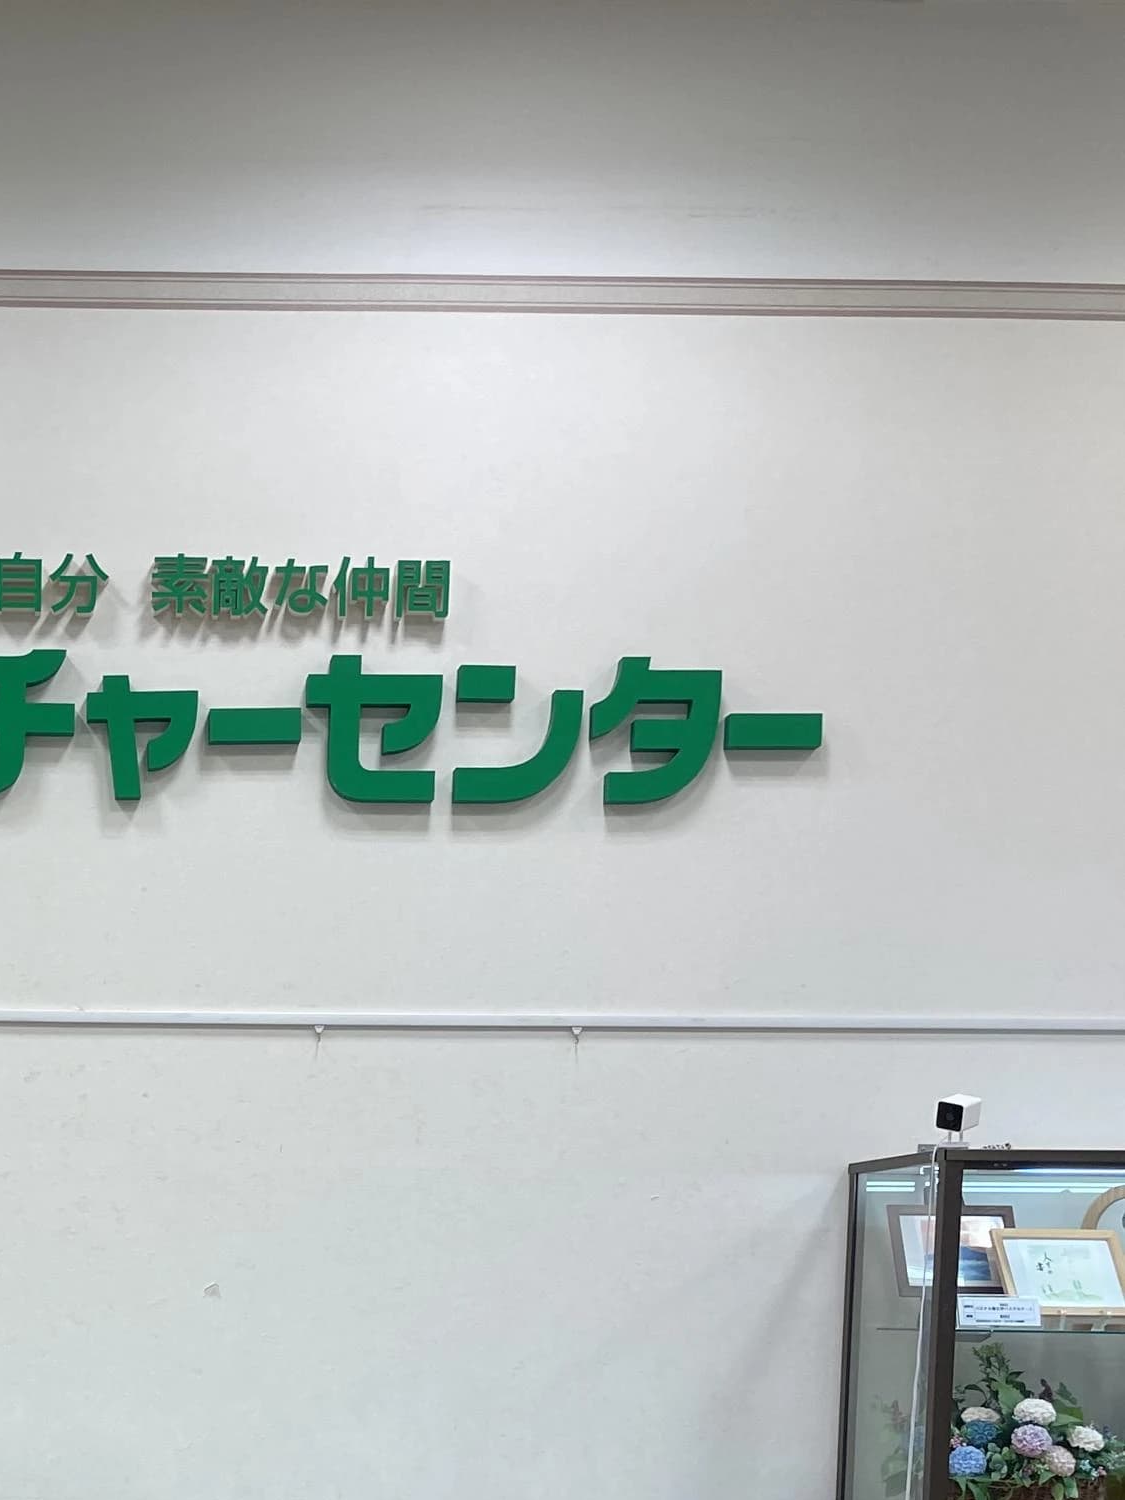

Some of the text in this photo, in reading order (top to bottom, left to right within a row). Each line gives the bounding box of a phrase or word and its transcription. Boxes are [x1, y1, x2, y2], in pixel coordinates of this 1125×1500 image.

[151, 553, 452, 619] 素敵な仲間
